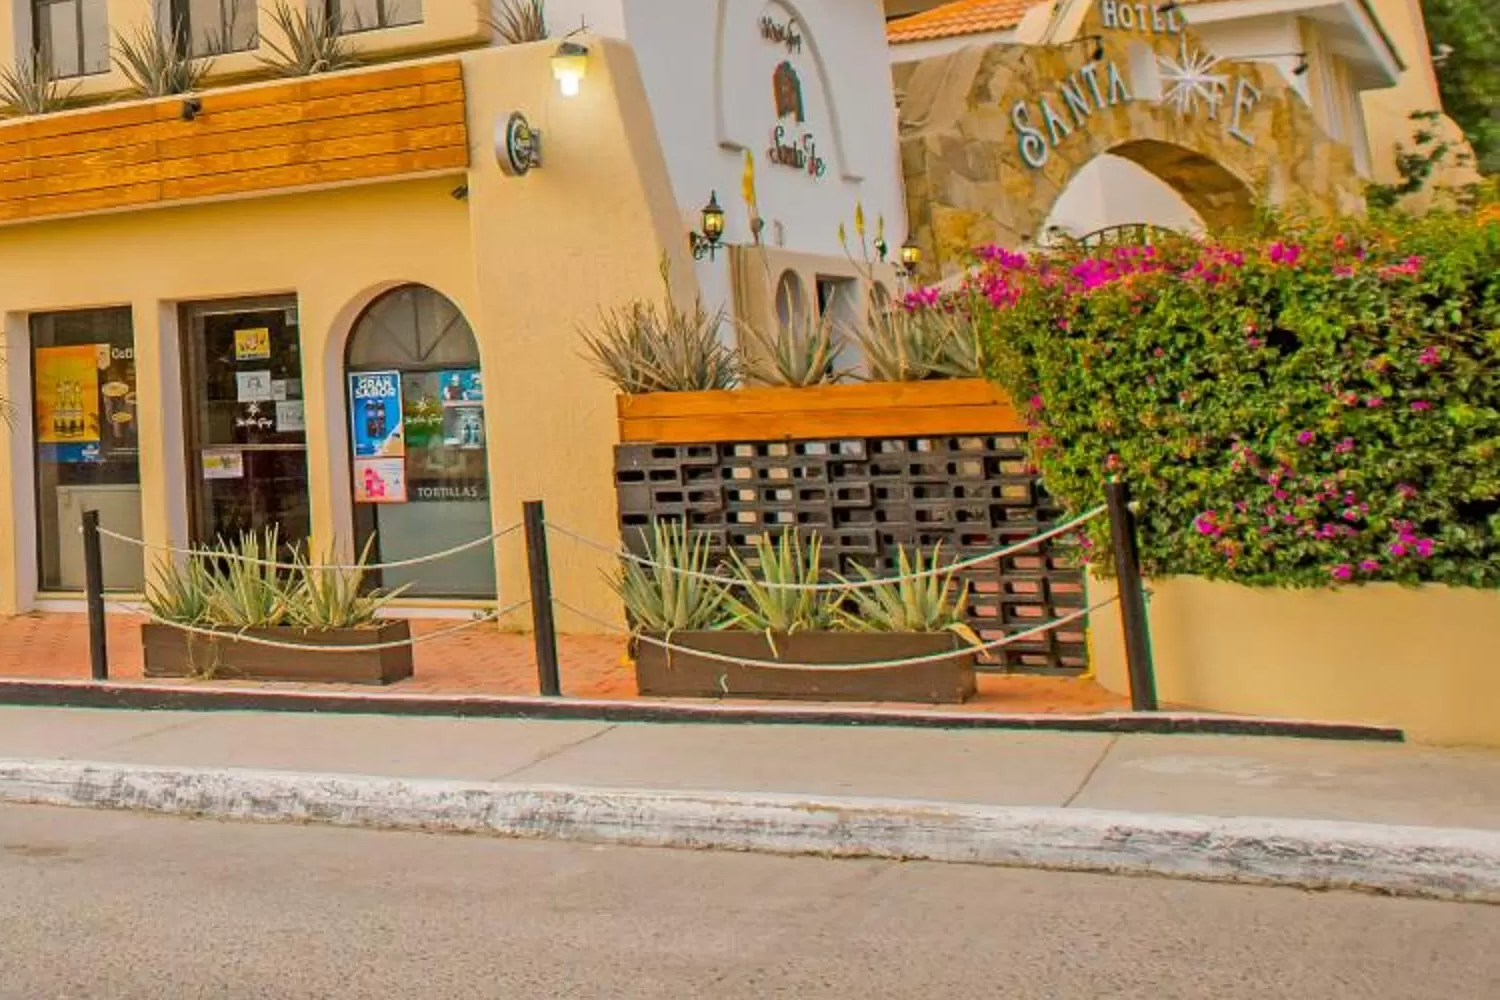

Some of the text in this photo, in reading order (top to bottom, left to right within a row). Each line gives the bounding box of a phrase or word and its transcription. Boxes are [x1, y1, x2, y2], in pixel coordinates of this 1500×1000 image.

[1010, 59, 1262, 168] SANTA FE
[417, 486, 478, 499] TORTILLAS
